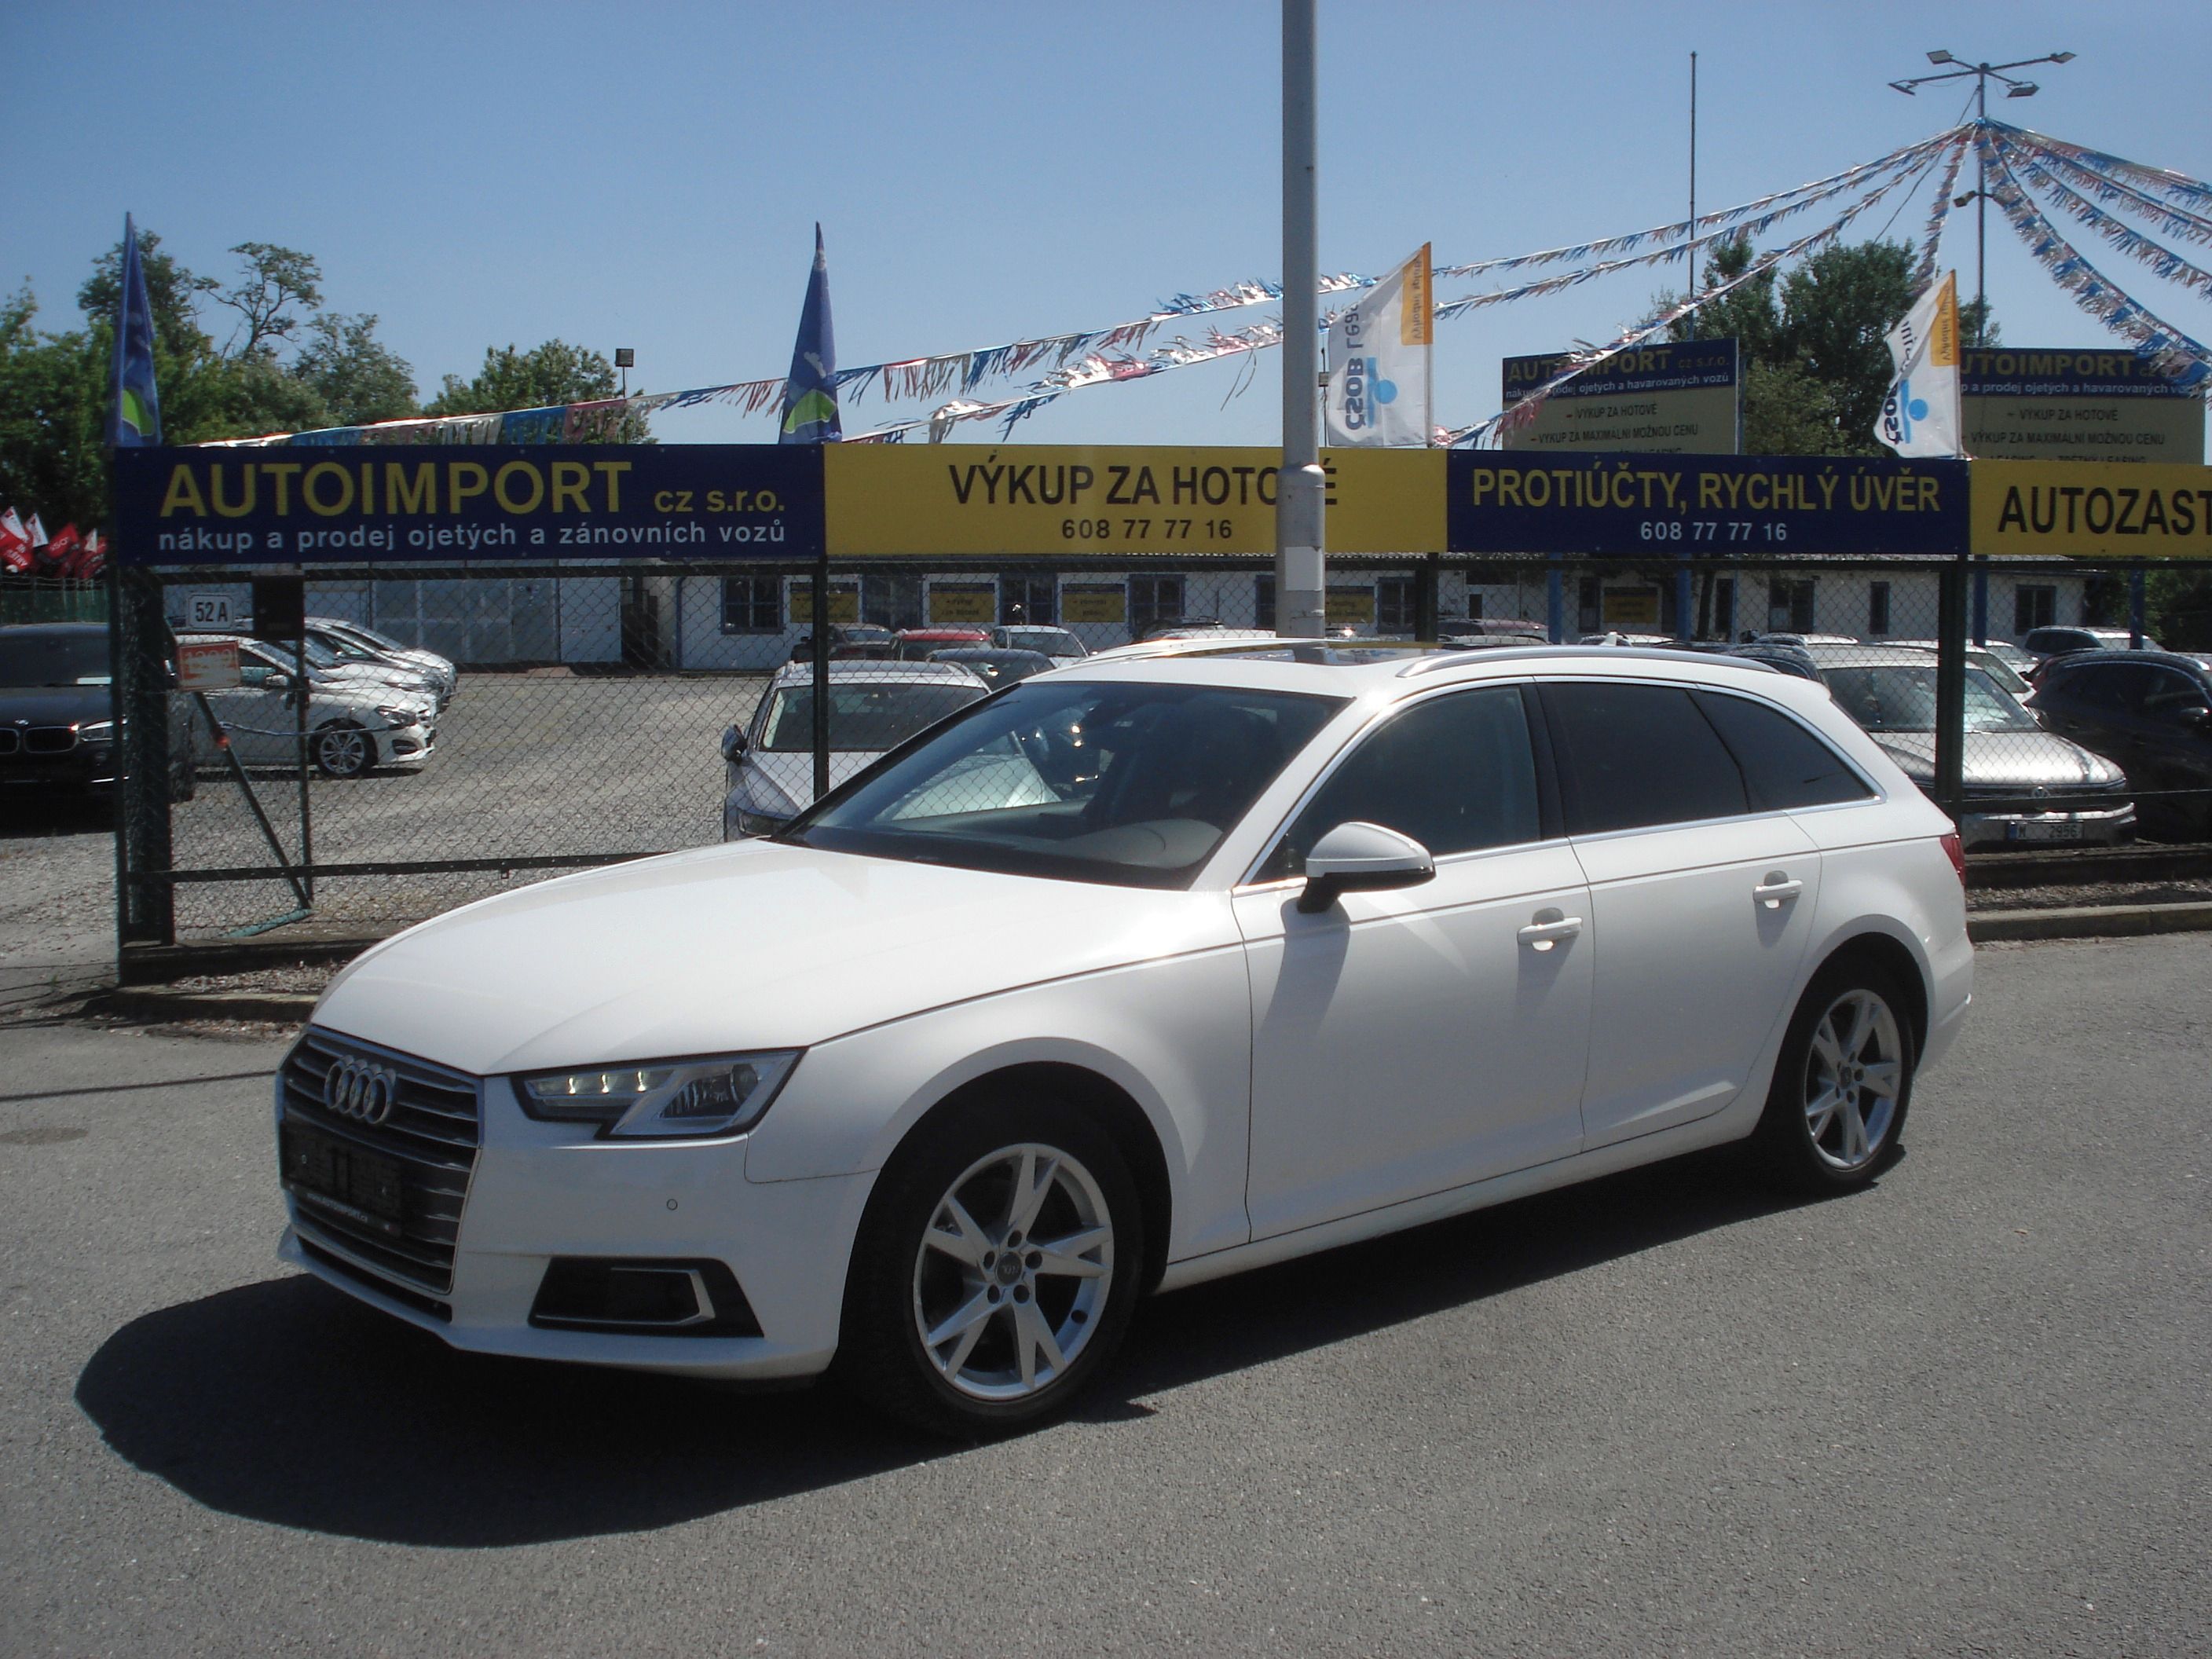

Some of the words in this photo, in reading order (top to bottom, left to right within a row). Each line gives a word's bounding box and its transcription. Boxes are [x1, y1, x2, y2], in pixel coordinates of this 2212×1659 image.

[1961, 353, 2137, 375] UTOIMPORT
[1579, 381, 1615, 394] ojetých
[1627, 375, 1700, 388] havarovaných
[1983, 382, 2021, 394] prodej
[2025, 382, 2069, 394] ojetých
[2073, 383, 2079, 392] a
[2083, 382, 2168, 395] havarovaných
[1608, 406, 1619, 417] ZA
[2058, 408, 2071, 420] ZA
[1569, 430, 1580, 442] ZA
[1633, 424, 1672, 438] MOŽNOU
[1673, 423, 1698, 436] CENU
[2009, 432, 2023, 443] ZA
[2087, 430, 2133, 444] MOŽNOU
[2137, 432, 2165, 445] CENU
[949, 453, 1094, 505] VÝKUP
[1106, 465, 1160, 505] ZA
[1173, 457, 1338, 505] HOTOÉ
[1473, 461, 1687, 515] PROTIÚČTY,
[1699, 466, 1840, 512] RYCHLÝ
[1850, 466, 1940, 512] ÚVĚR
[159, 461, 632, 518] AUTOIMPORT
[654, 489, 693, 512] cz
[707, 489, 784, 512] s.r.o.
[159, 527, 253, 553] nákup
[267, 533, 283, 548] a
[298, 525, 394, 552] prodej
[408, 522, 515, 551] ojetých
[530, 529, 545, 544] a
[559, 521, 705, 545] zánovních
[720, 519, 784, 543] vozů
[1062, 519, 1110, 540] 608
[1123, 519, 1149, 540] 77
[1165, 519, 1190, 540] 77
[1207, 519, 1232, 540] 16
[1640, 522, 1683, 540] 608
[1694, 522, 1718, 540] 77
[1728, 522, 1752, 541] 77
[1764, 522, 1787, 541] 16
